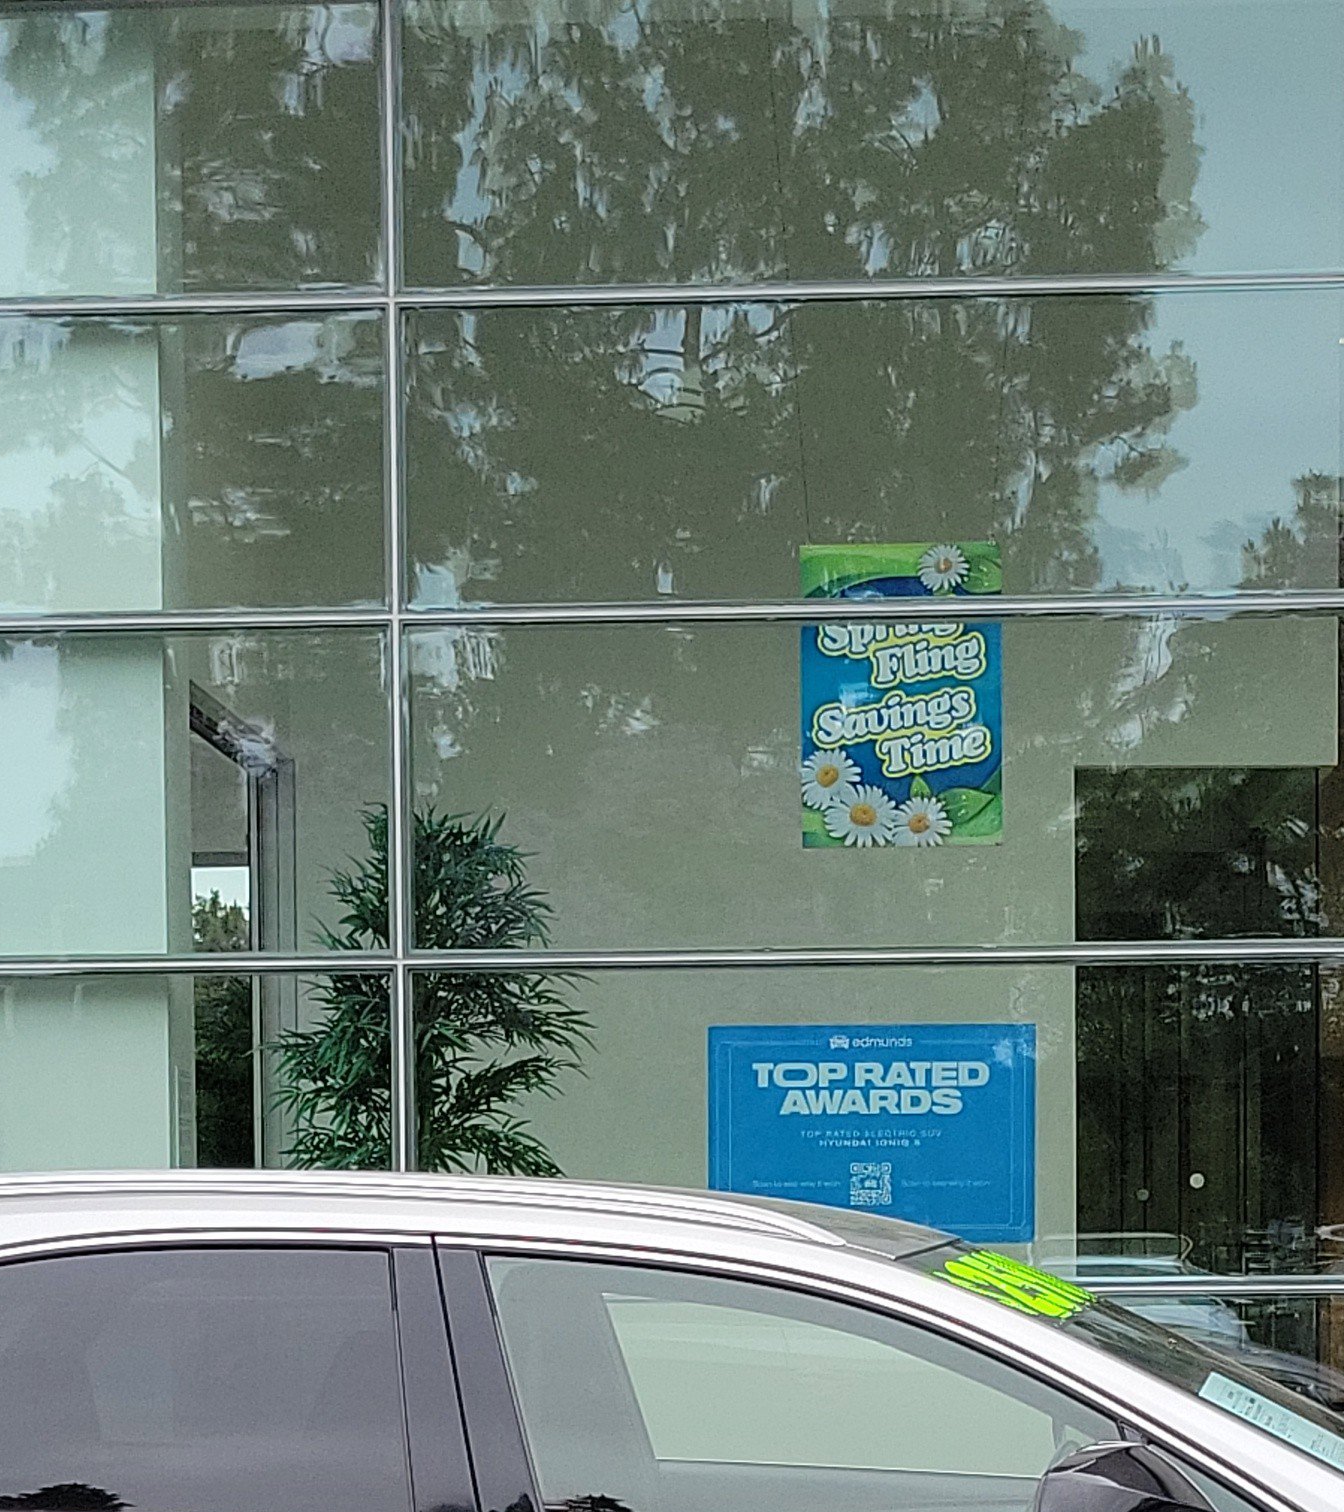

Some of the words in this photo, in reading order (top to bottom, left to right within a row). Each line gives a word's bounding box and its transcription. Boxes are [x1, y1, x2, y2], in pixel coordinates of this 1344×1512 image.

[875, 637, 979, 684] Fling
[817, 691, 971, 743] Savings
[882, 730, 985, 772] Time
[852, 1037, 913, 1048] edmunds
[752, 1062, 849, 1087] TOP
[854, 1061, 990, 1087] RATED
[779, 1089, 964, 1115] AWARDS
